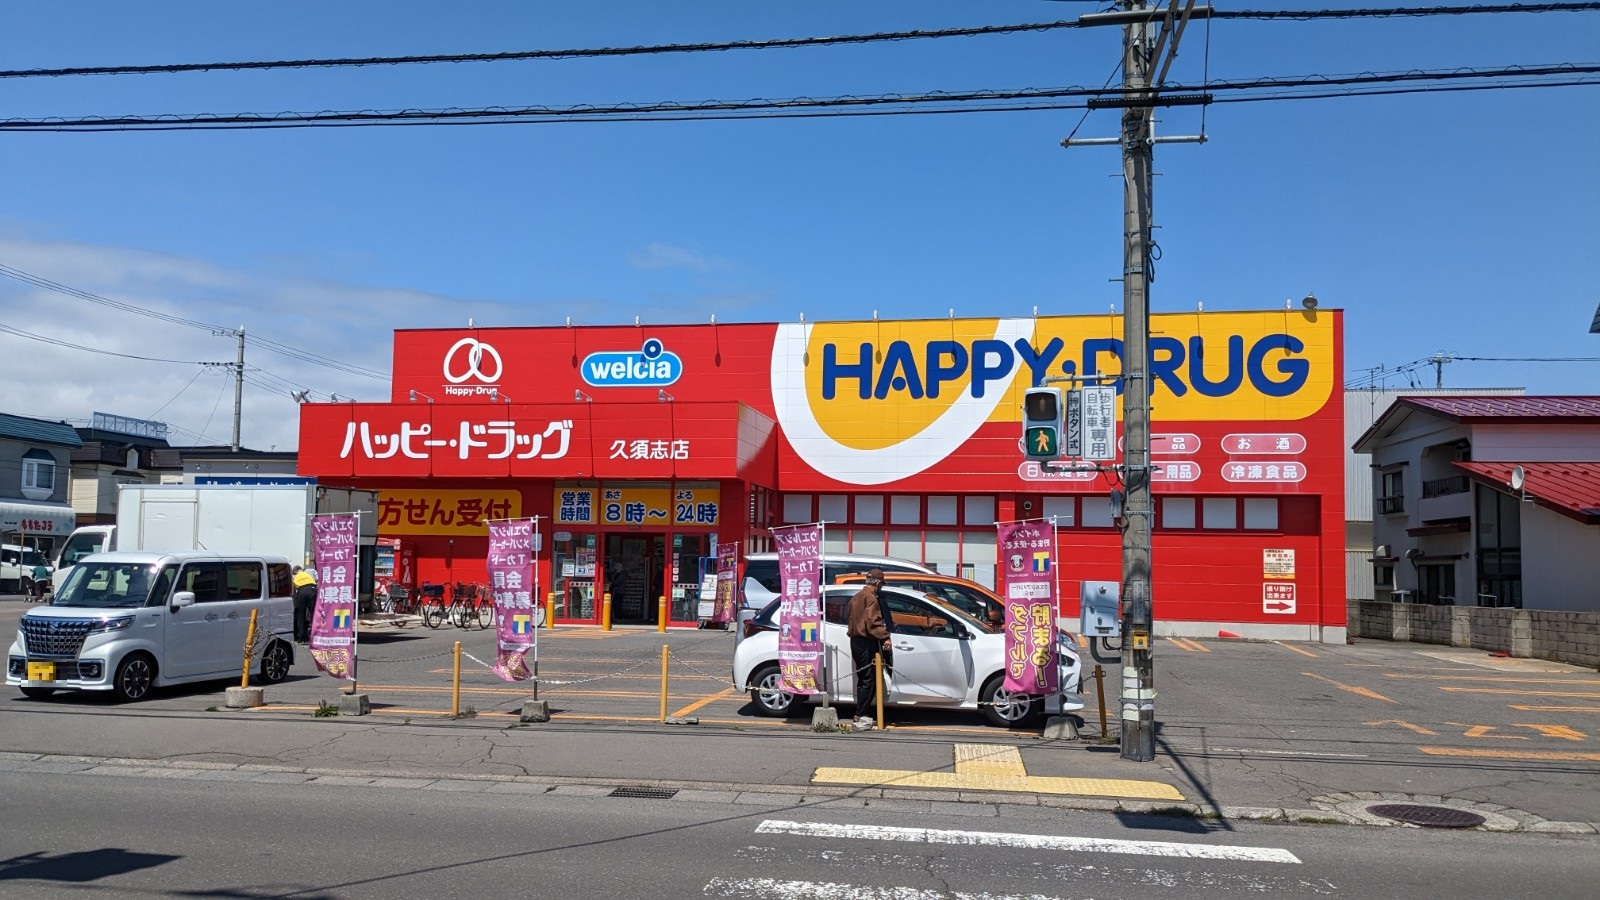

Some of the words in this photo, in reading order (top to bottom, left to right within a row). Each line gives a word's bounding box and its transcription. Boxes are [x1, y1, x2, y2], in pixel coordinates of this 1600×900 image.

[590, 349, 672, 380] welcia
[1087, 393, 1098, 428] 自転車
[1100, 393, 1111, 428] 歩行者
[1069, 397, 1079, 449] 押ボタン式
[340, 420, 573, 460] ハッピー・ドラッグ
[609, 440, 690, 460] 久須志店
[1091, 429, 1107, 457] 専用
[1230, 465, 1298, 479] 冷凍食品
[561, 491, 591, 506] 営業
[604, 490, 621, 500] あさ
[676, 490, 693, 500] よる
[560, 506, 591, 522] 時間
[675, 502, 718, 524] 24時
